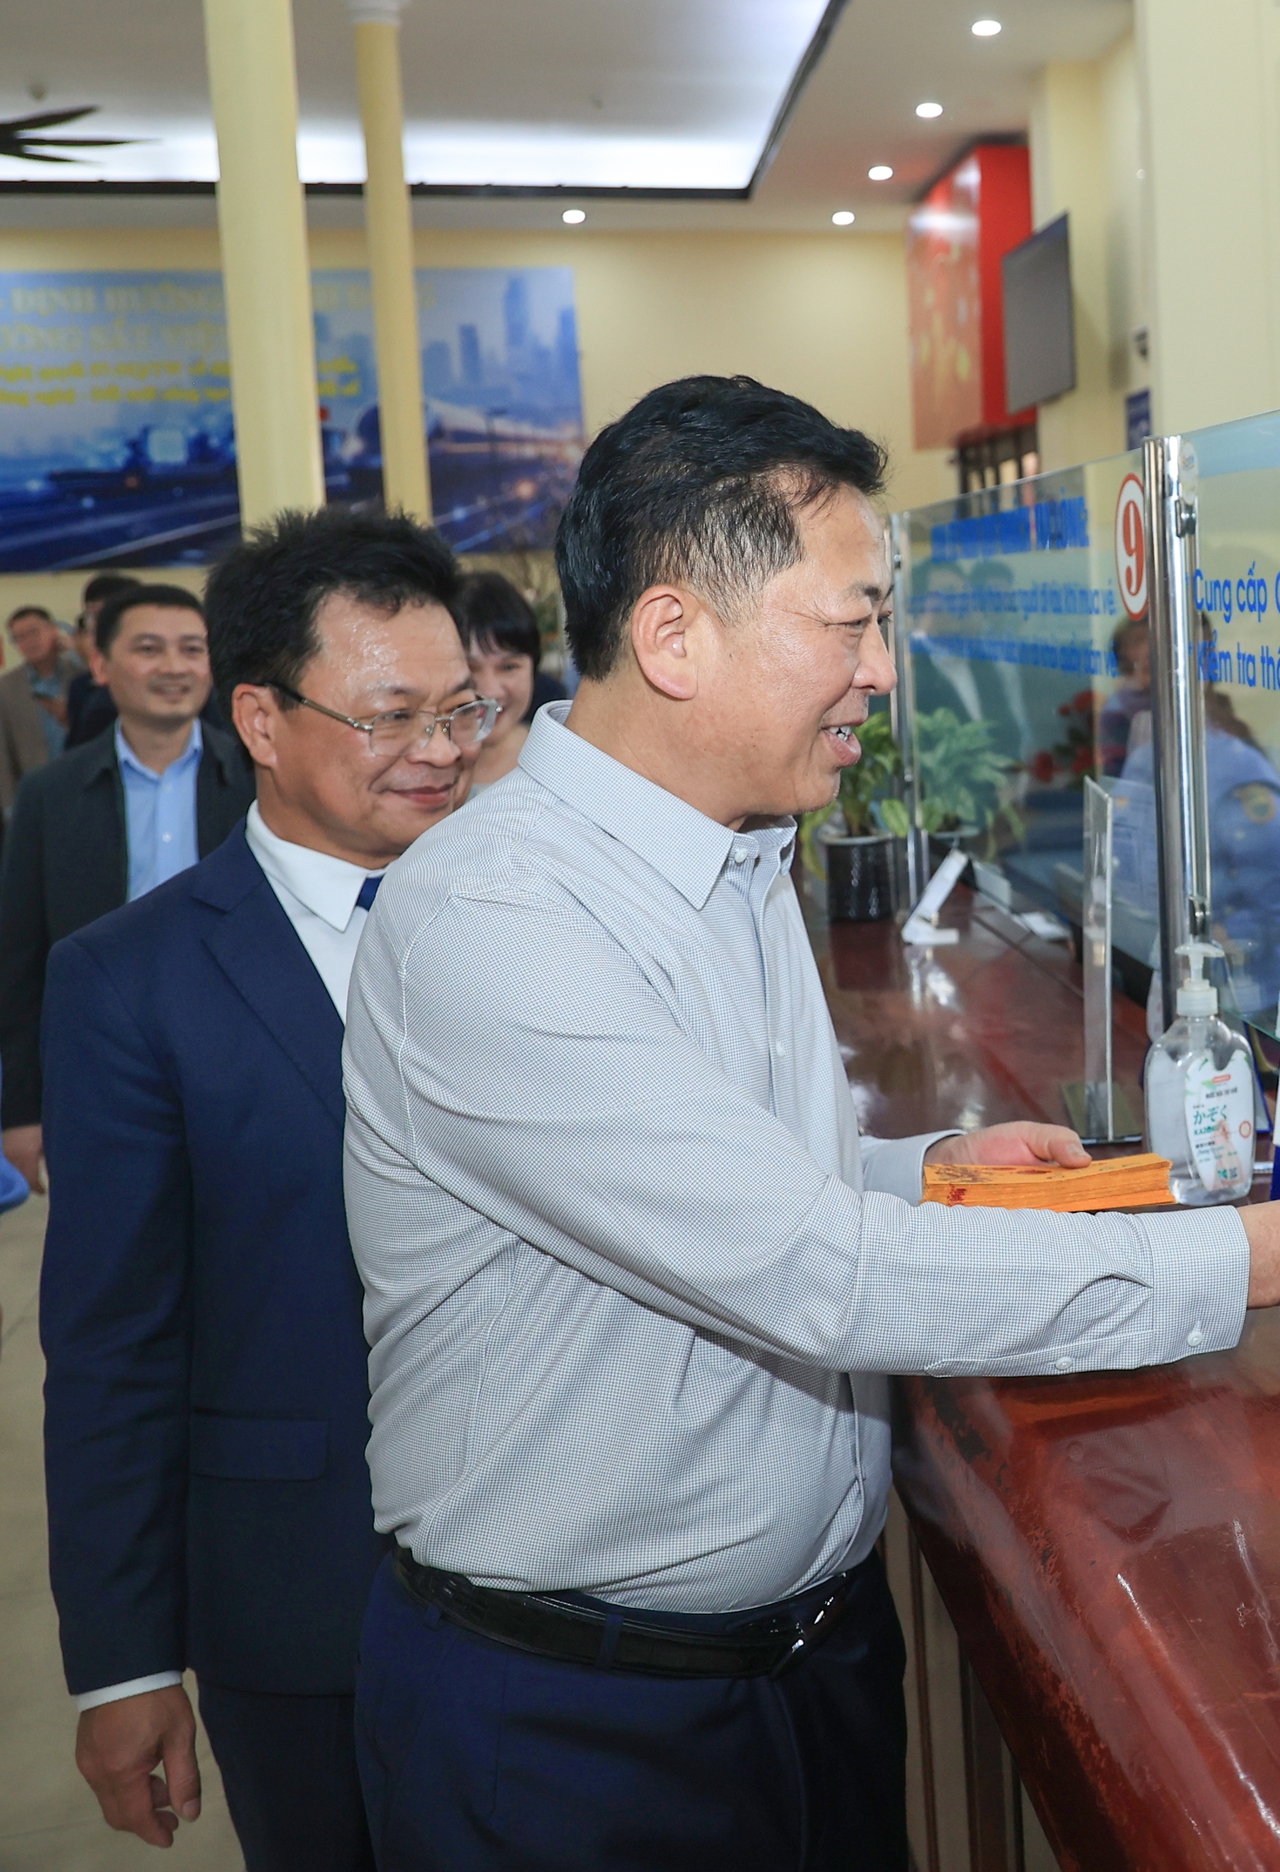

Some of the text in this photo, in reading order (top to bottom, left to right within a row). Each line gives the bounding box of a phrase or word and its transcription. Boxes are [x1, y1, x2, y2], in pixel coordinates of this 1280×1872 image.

[1123, 501, 1144, 596] 9
[1193, 569, 1232, 623] Cung
[1236, 561, 1268, 622] cấp
[1236, 642, 1257, 687] tra
